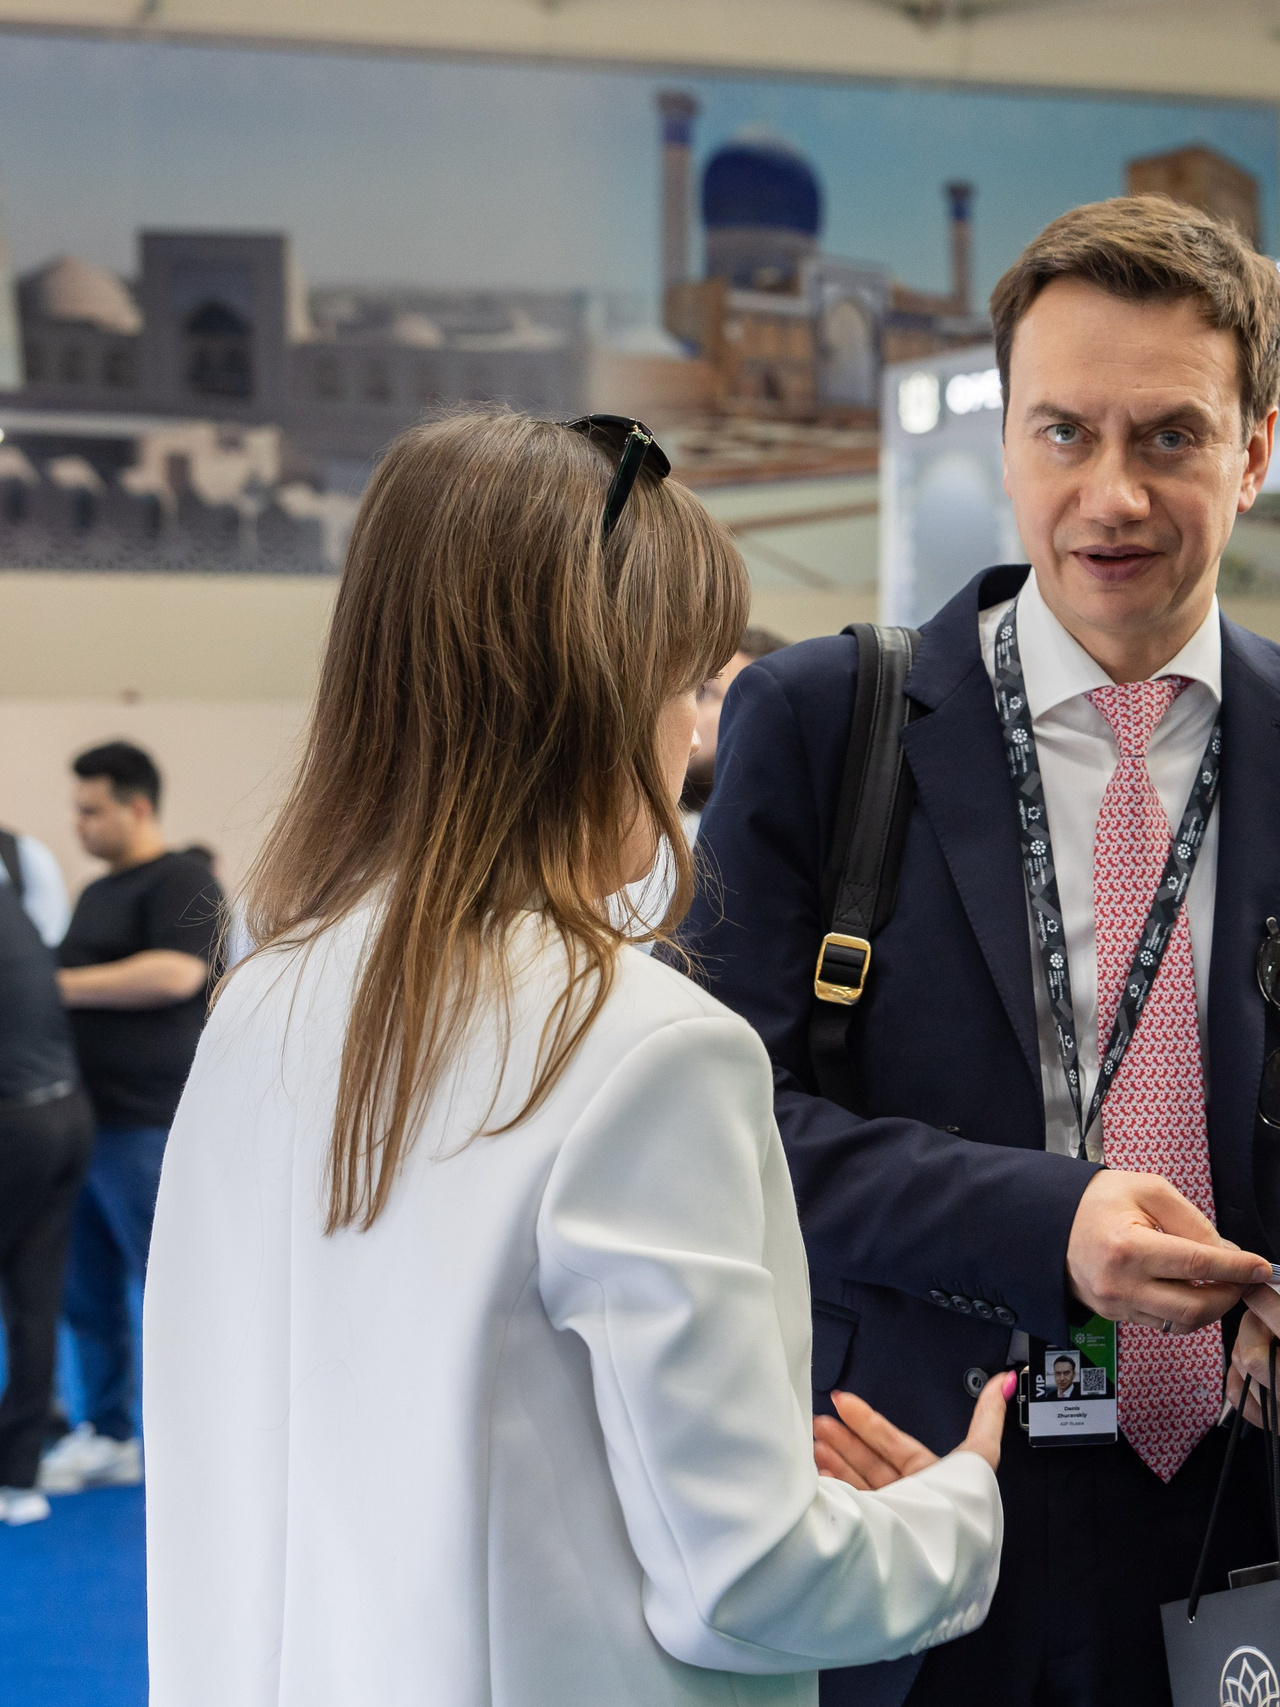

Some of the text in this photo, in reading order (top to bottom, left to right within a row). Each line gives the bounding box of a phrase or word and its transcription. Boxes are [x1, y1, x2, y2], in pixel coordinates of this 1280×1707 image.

[1001, 690, 1010, 720] INNOPROM
[1175, 872, 1188, 903] INNOPROM
[1038, 911, 1048, 942] INNOPROM
[1135, 980, 1149, 1011] INNOPROM
[1035, 1374, 1046, 1398] VIP
